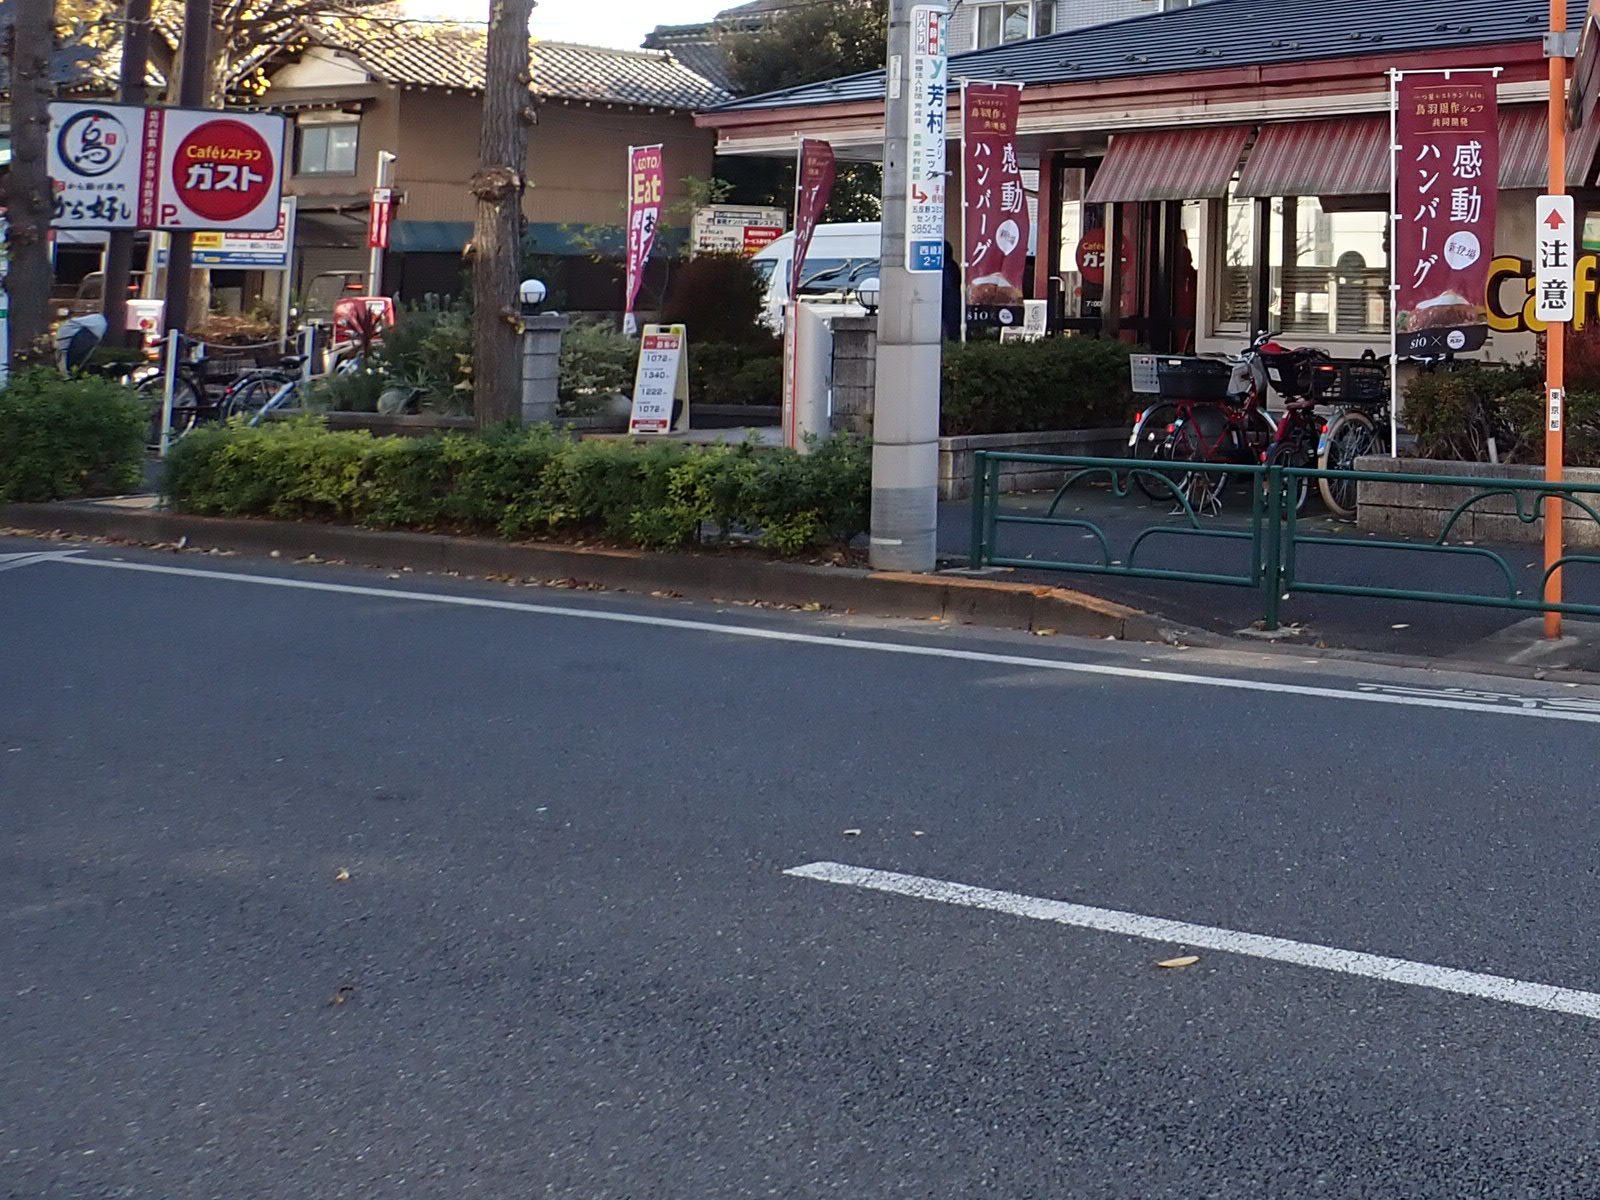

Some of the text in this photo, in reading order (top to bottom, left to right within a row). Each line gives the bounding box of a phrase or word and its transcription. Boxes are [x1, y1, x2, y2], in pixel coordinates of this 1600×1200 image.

[1432, 118, 1469, 127] 共同開発
[187, 145, 262, 161] Caféレストラン
[186, 163, 263, 192] ガスト
[634, 173, 661, 204] Eat
[1001, 143, 1023, 213] 感動
[1449, 141, 1482, 223] 感動
[161, 204, 178, 224] P
[972, 143, 992, 266] ハンバーグ
[1413, 144, 1440, 289] ハンバーグ
[1541, 240, 1568, 310] 注意
[1410, 333, 1427, 350] sio
[1551, 391, 1559, 429] 東京都
